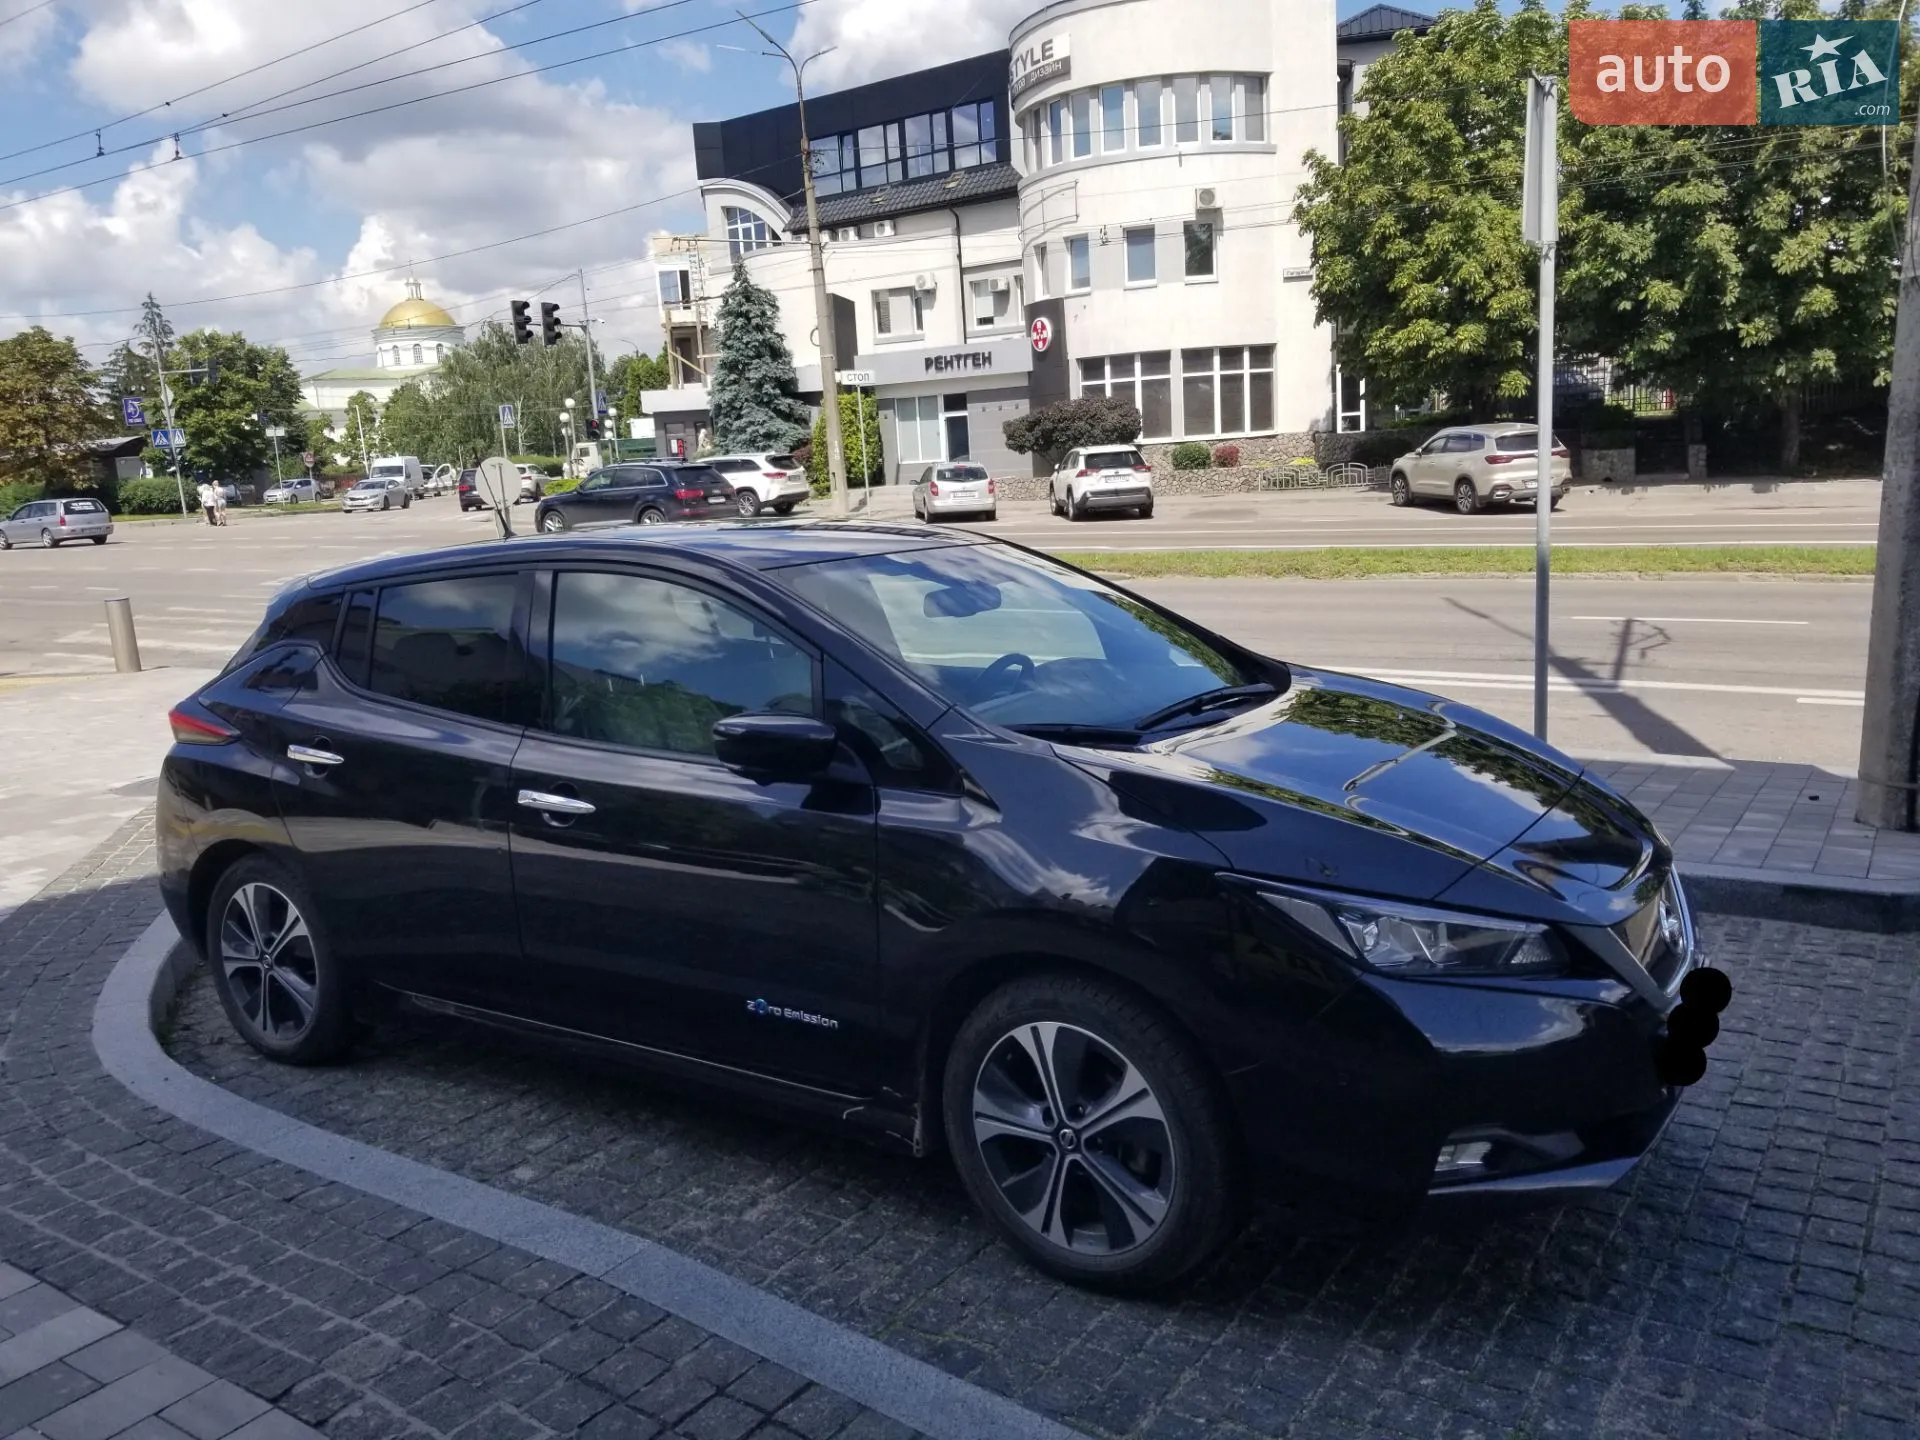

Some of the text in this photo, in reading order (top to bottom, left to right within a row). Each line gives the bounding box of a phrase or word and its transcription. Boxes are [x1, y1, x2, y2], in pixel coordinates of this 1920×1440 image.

[1030, 61, 1062, 83] дизайн
[924, 350, 992, 373] РЕНТГЕН
[847, 373, 870, 382] СТОП
[783, 1007, 839, 1029] Emission
